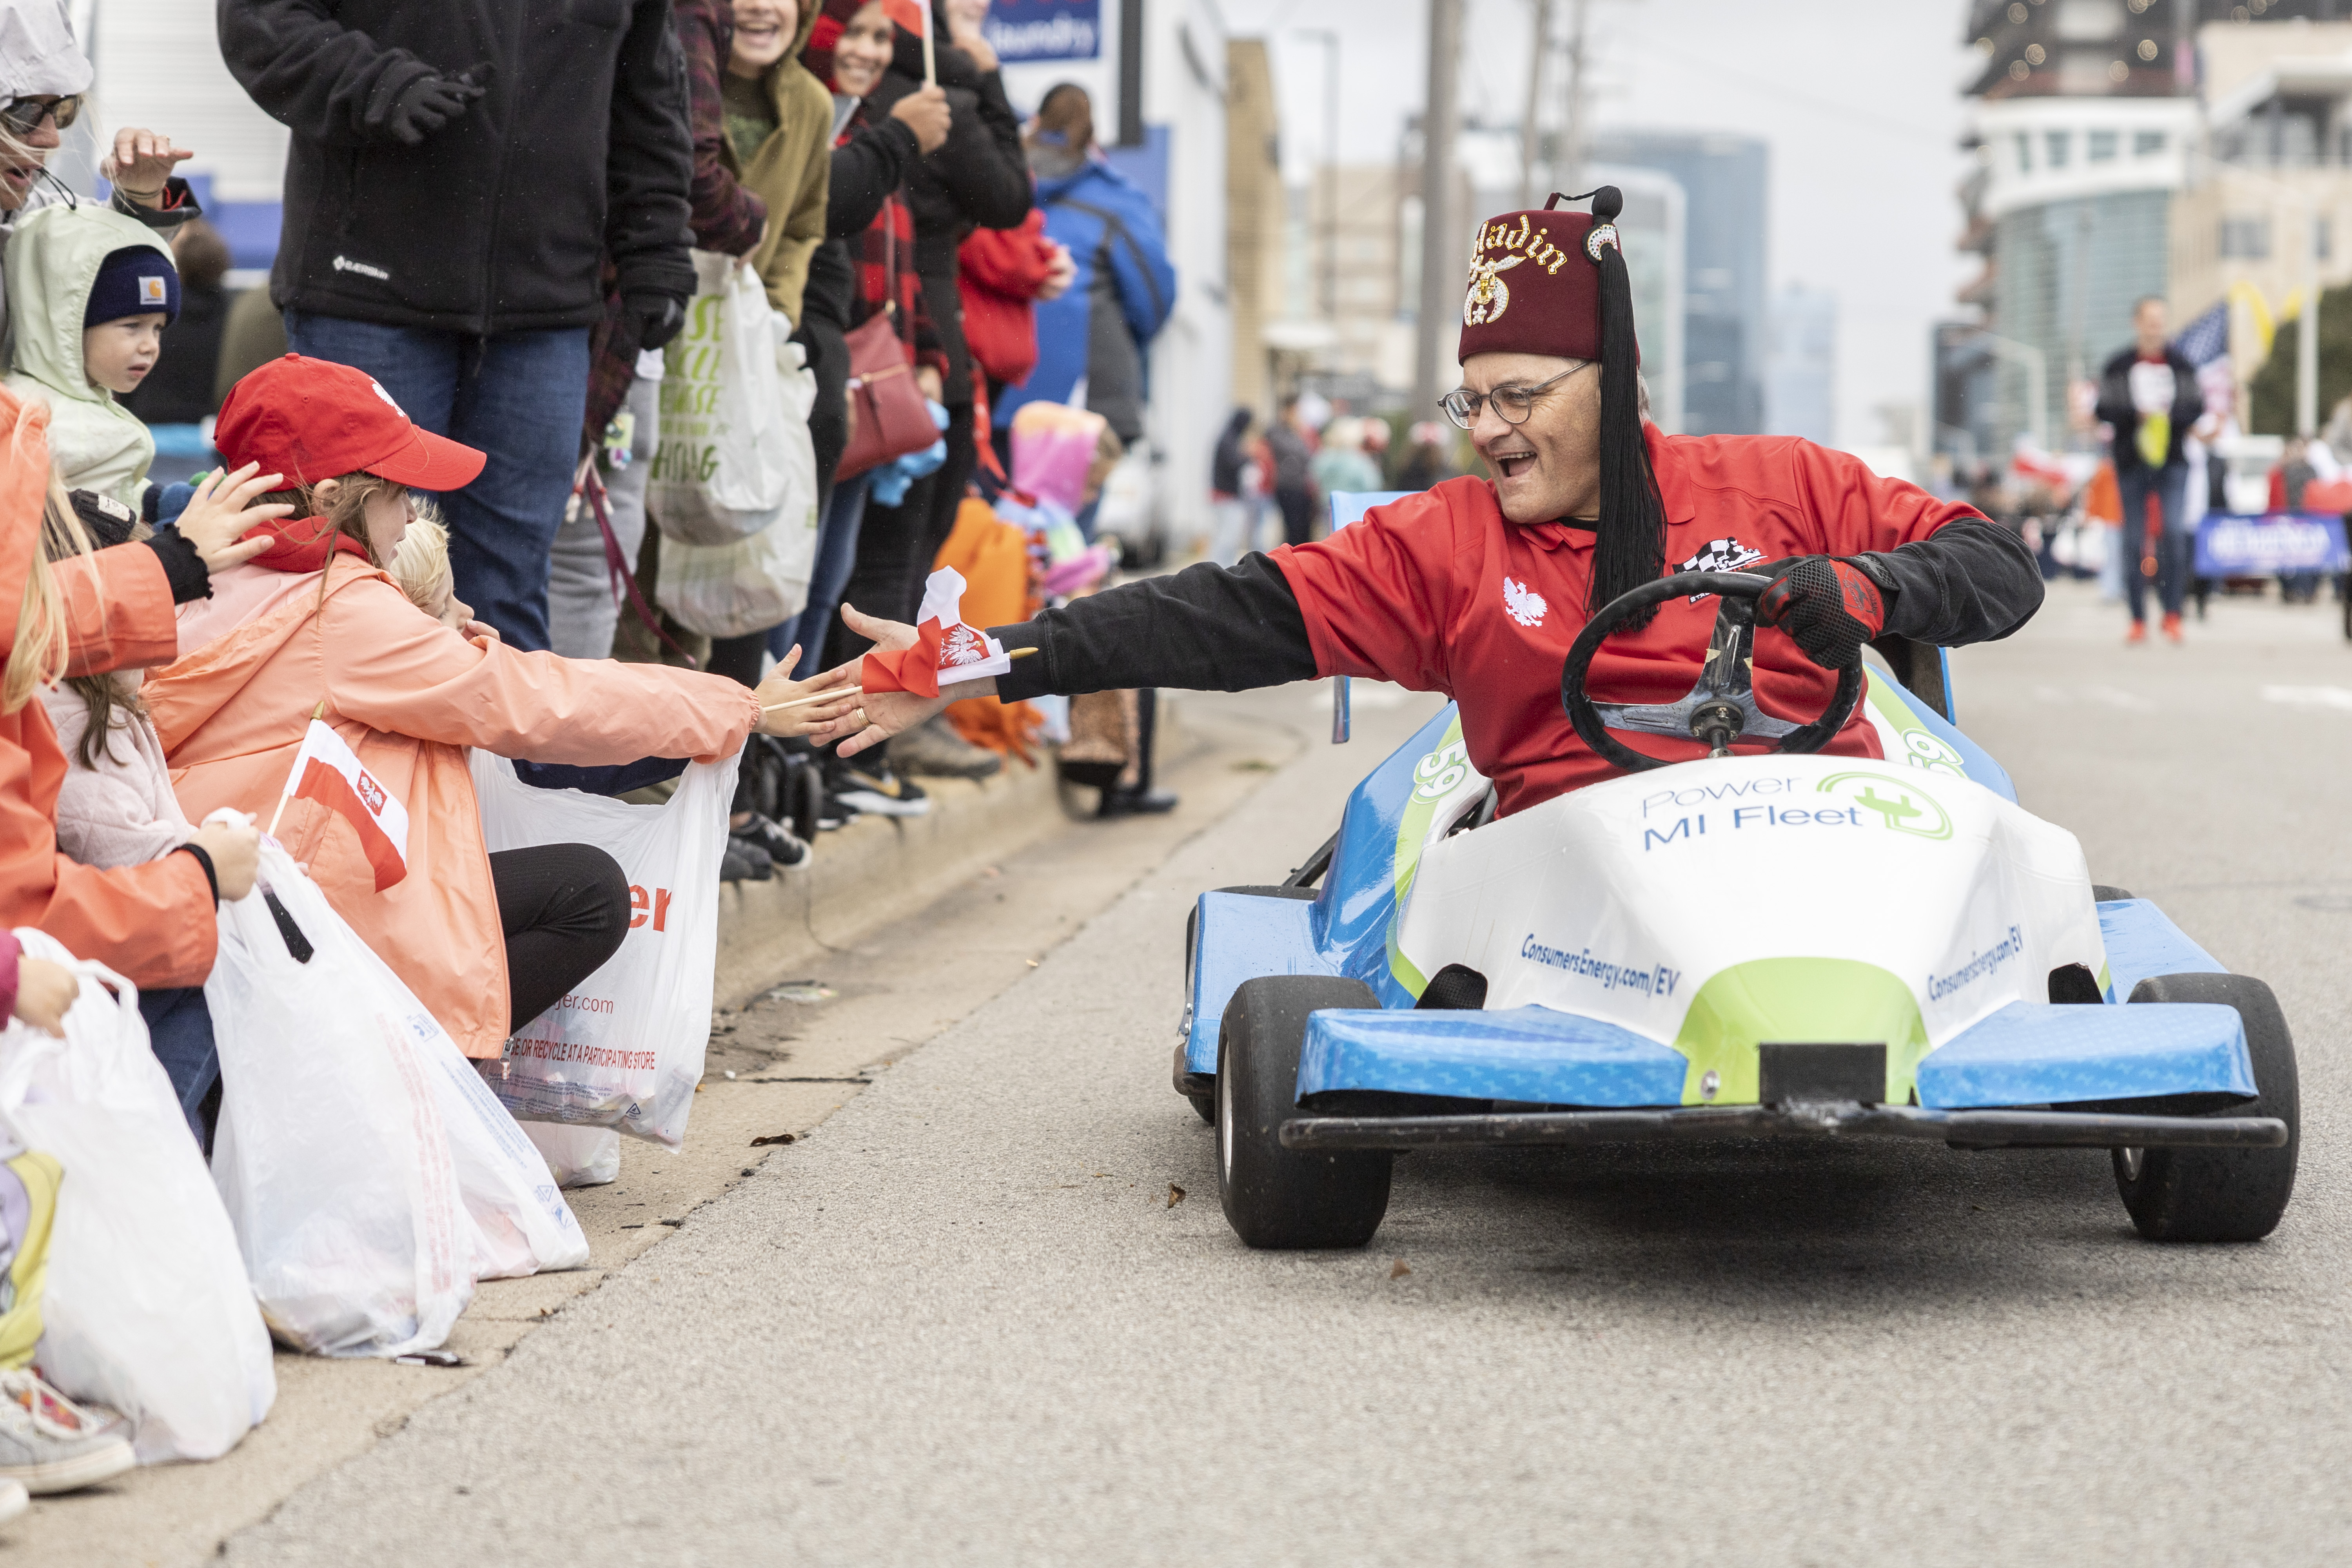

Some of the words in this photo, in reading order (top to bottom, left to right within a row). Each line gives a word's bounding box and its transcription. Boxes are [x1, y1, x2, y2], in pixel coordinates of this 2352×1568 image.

[1643, 777, 1802, 818] Power
[1644, 814, 1706, 851] MI
[1734, 806, 1863, 829] Fleet
[628, 884, 672, 932] er
[1521, 933, 1681, 998] ConsumersEnergy.com/EV
[554, 994, 614, 1014] jer.com
[521, 1038, 532, 1056] OR
[533, 1040, 567, 1061] RECYCLE
[566, 1044, 577, 1062] AT
[575, 1045, 583, 1063] A
[583, 1045, 632, 1069] PARTICIPATING
[633, 1051, 655, 1070] STORE
